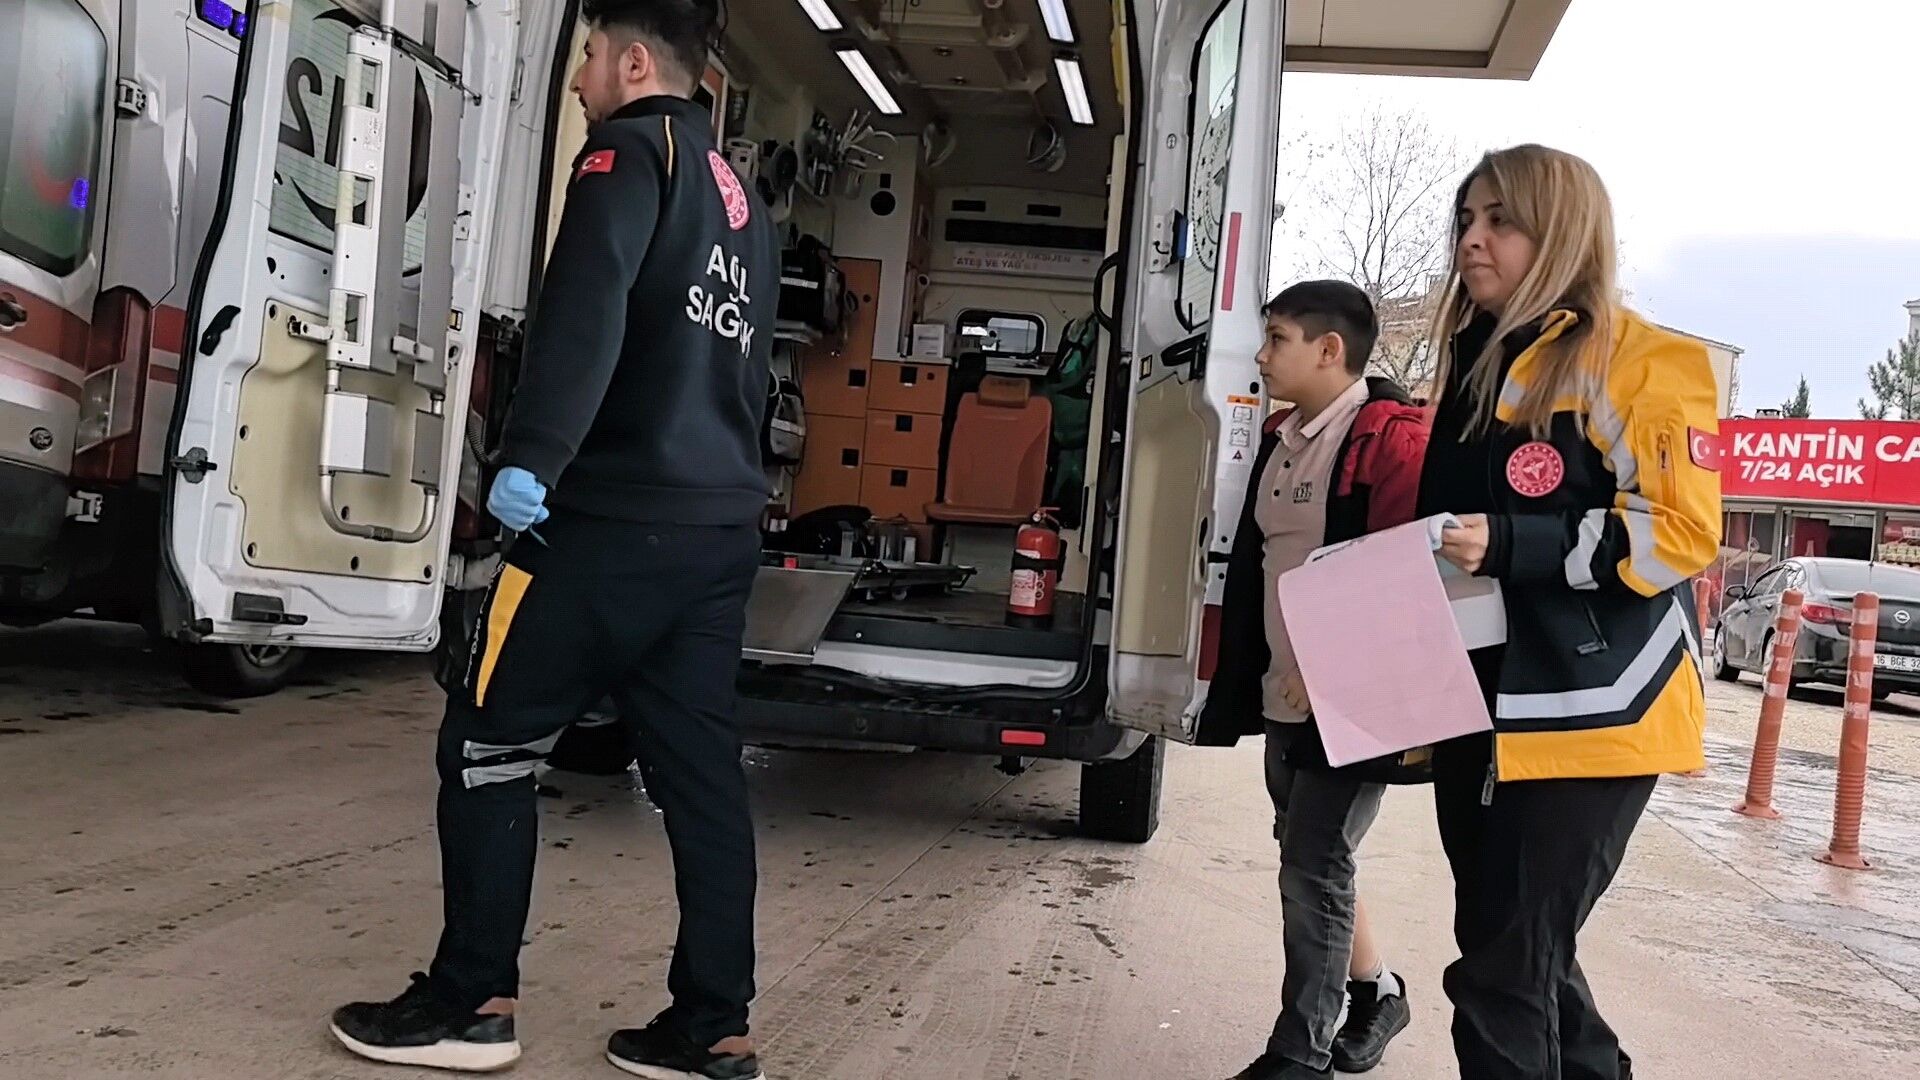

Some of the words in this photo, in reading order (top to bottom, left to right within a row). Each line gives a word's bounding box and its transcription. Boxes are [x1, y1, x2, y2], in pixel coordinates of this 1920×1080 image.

[1732, 427, 1865, 461] KANTİN
[1739, 460, 1792, 483] 7/24
[1796, 463, 1866, 488] AÇIK
[1876, 654, 1886, 665] 16
